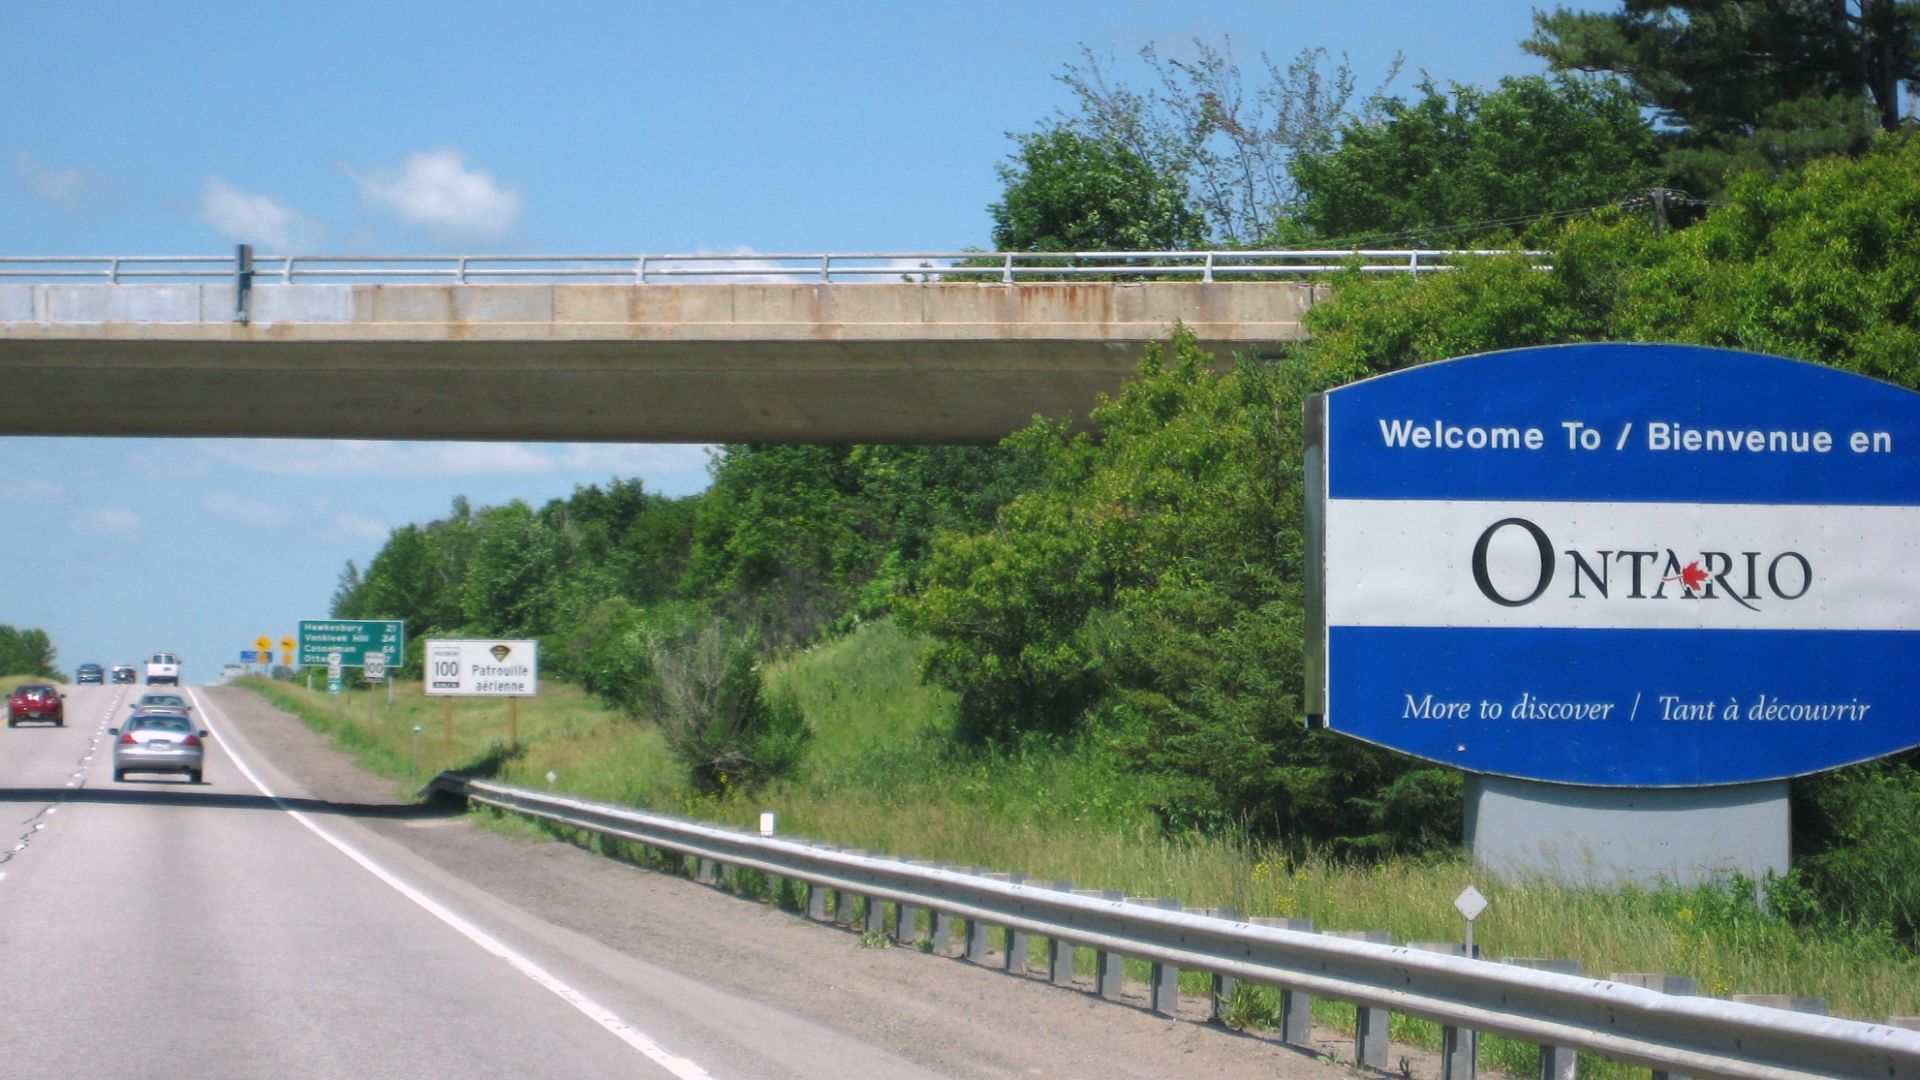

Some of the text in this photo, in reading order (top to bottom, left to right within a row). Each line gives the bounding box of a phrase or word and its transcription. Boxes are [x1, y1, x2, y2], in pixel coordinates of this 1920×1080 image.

[1379, 419, 1892, 453] Welcome To / Bienvenue en
[1471, 517, 1813, 612] ONTARIO
[304, 623, 396, 633] Hawkesbury 21
[304, 634, 347, 642] Vankleek
[381, 634, 396, 643] 24
[304, 644, 356, 652] Casselman
[435, 661, 458, 677] 100
[472, 664, 528, 676] Patrouille
[476, 680, 525, 692] aérienne
[1402, 692, 1871, 722] More to discover / Tant à découvrir
